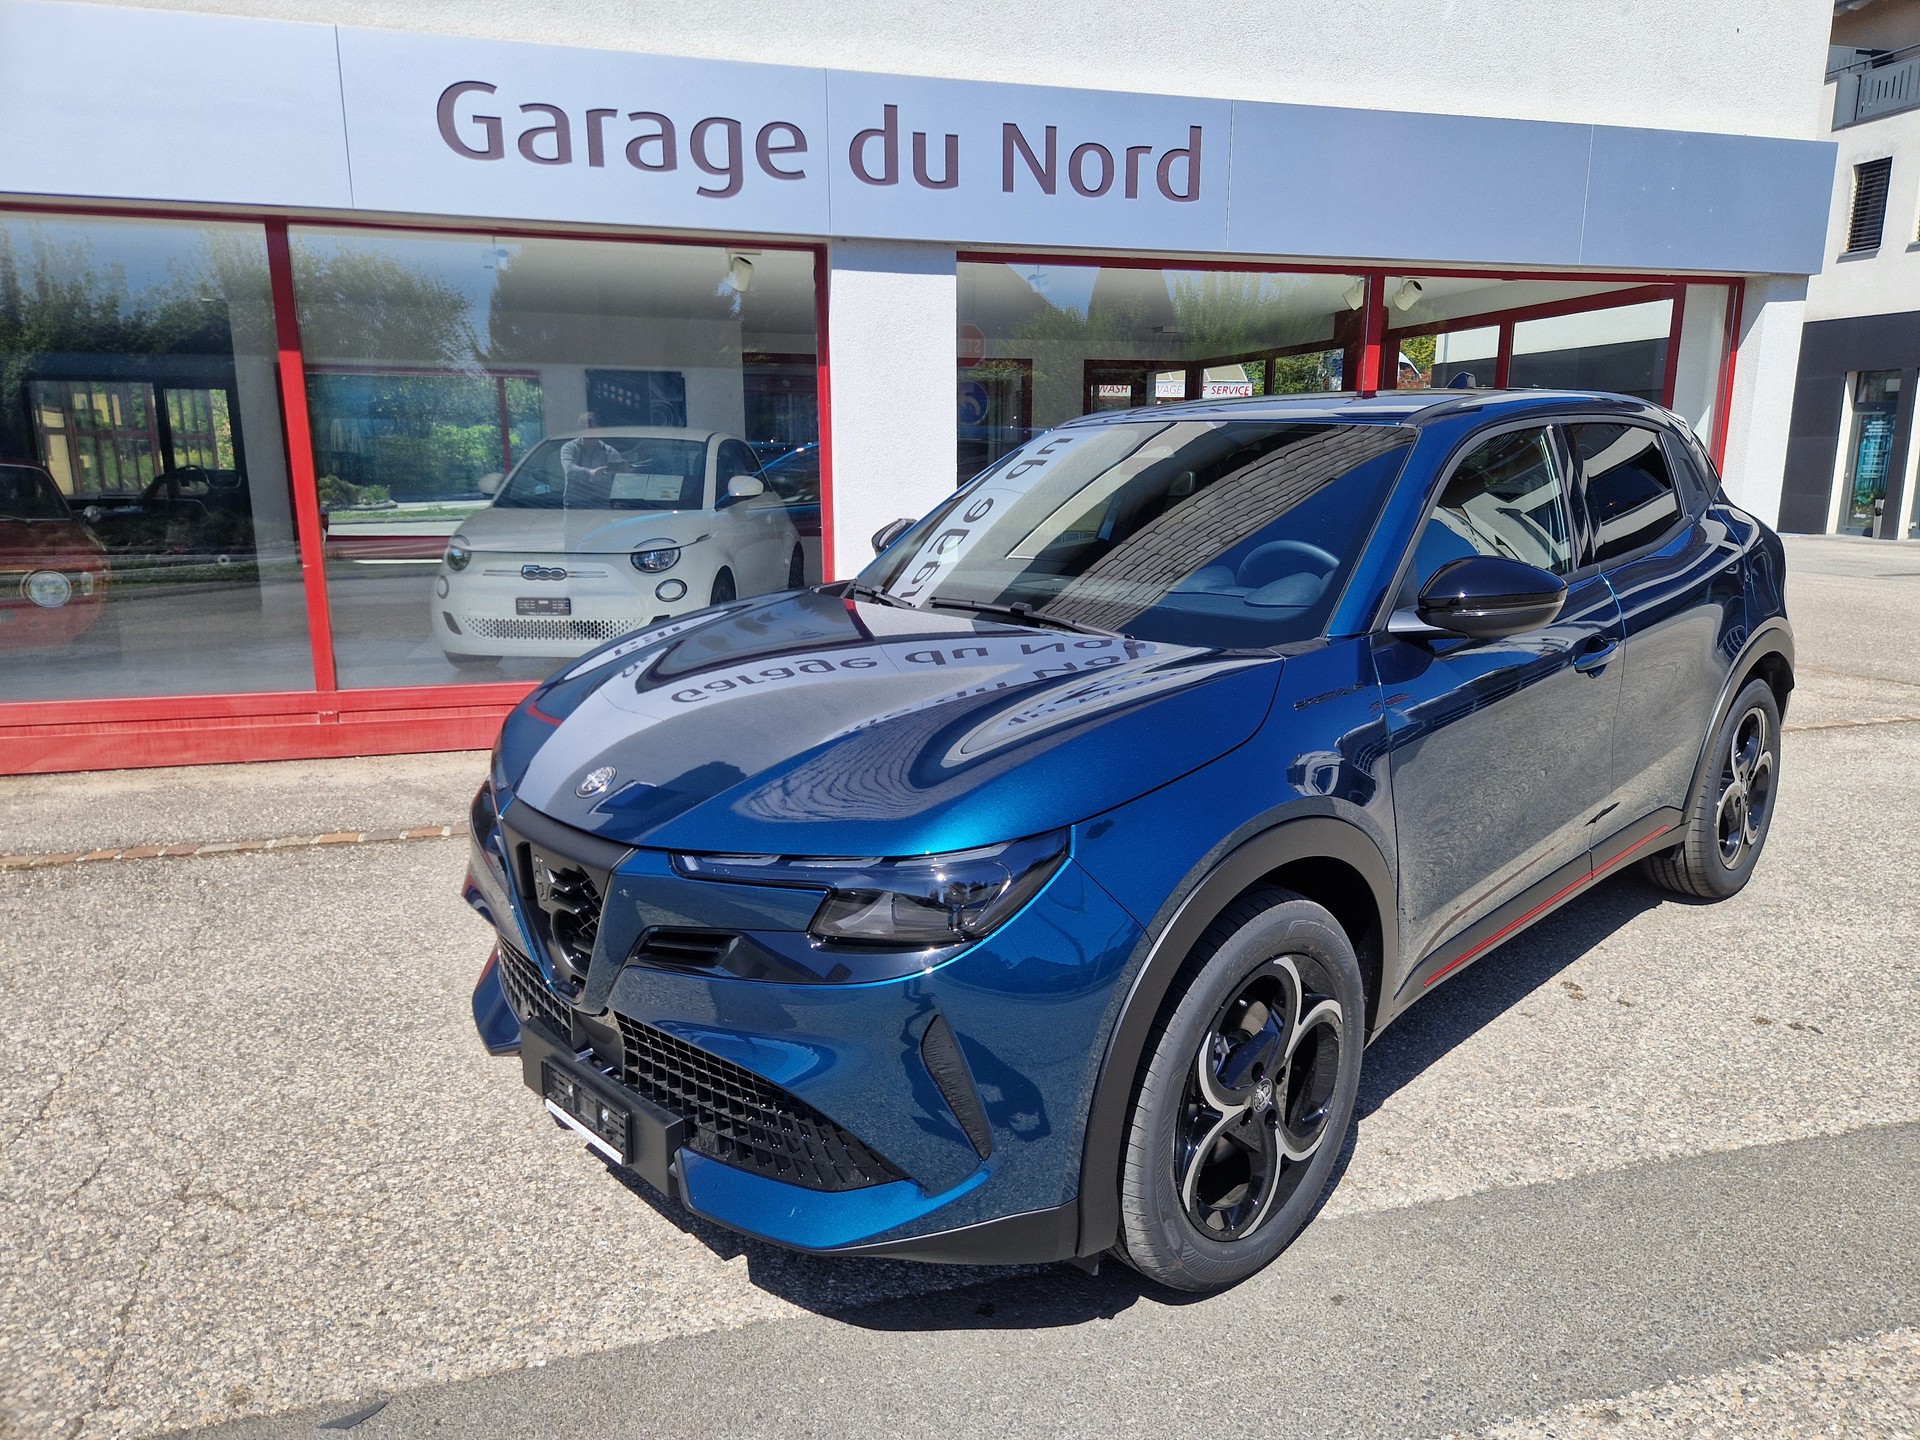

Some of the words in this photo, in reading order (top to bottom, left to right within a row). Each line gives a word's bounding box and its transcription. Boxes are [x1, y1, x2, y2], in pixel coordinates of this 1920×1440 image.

[436, 80, 808, 199] Garage
[848, 103, 959, 190] du
[1002, 122, 1203, 203] Nord
[1211, 386, 1249, 396] SERVICE
[521, 565, 567, 581] 500
